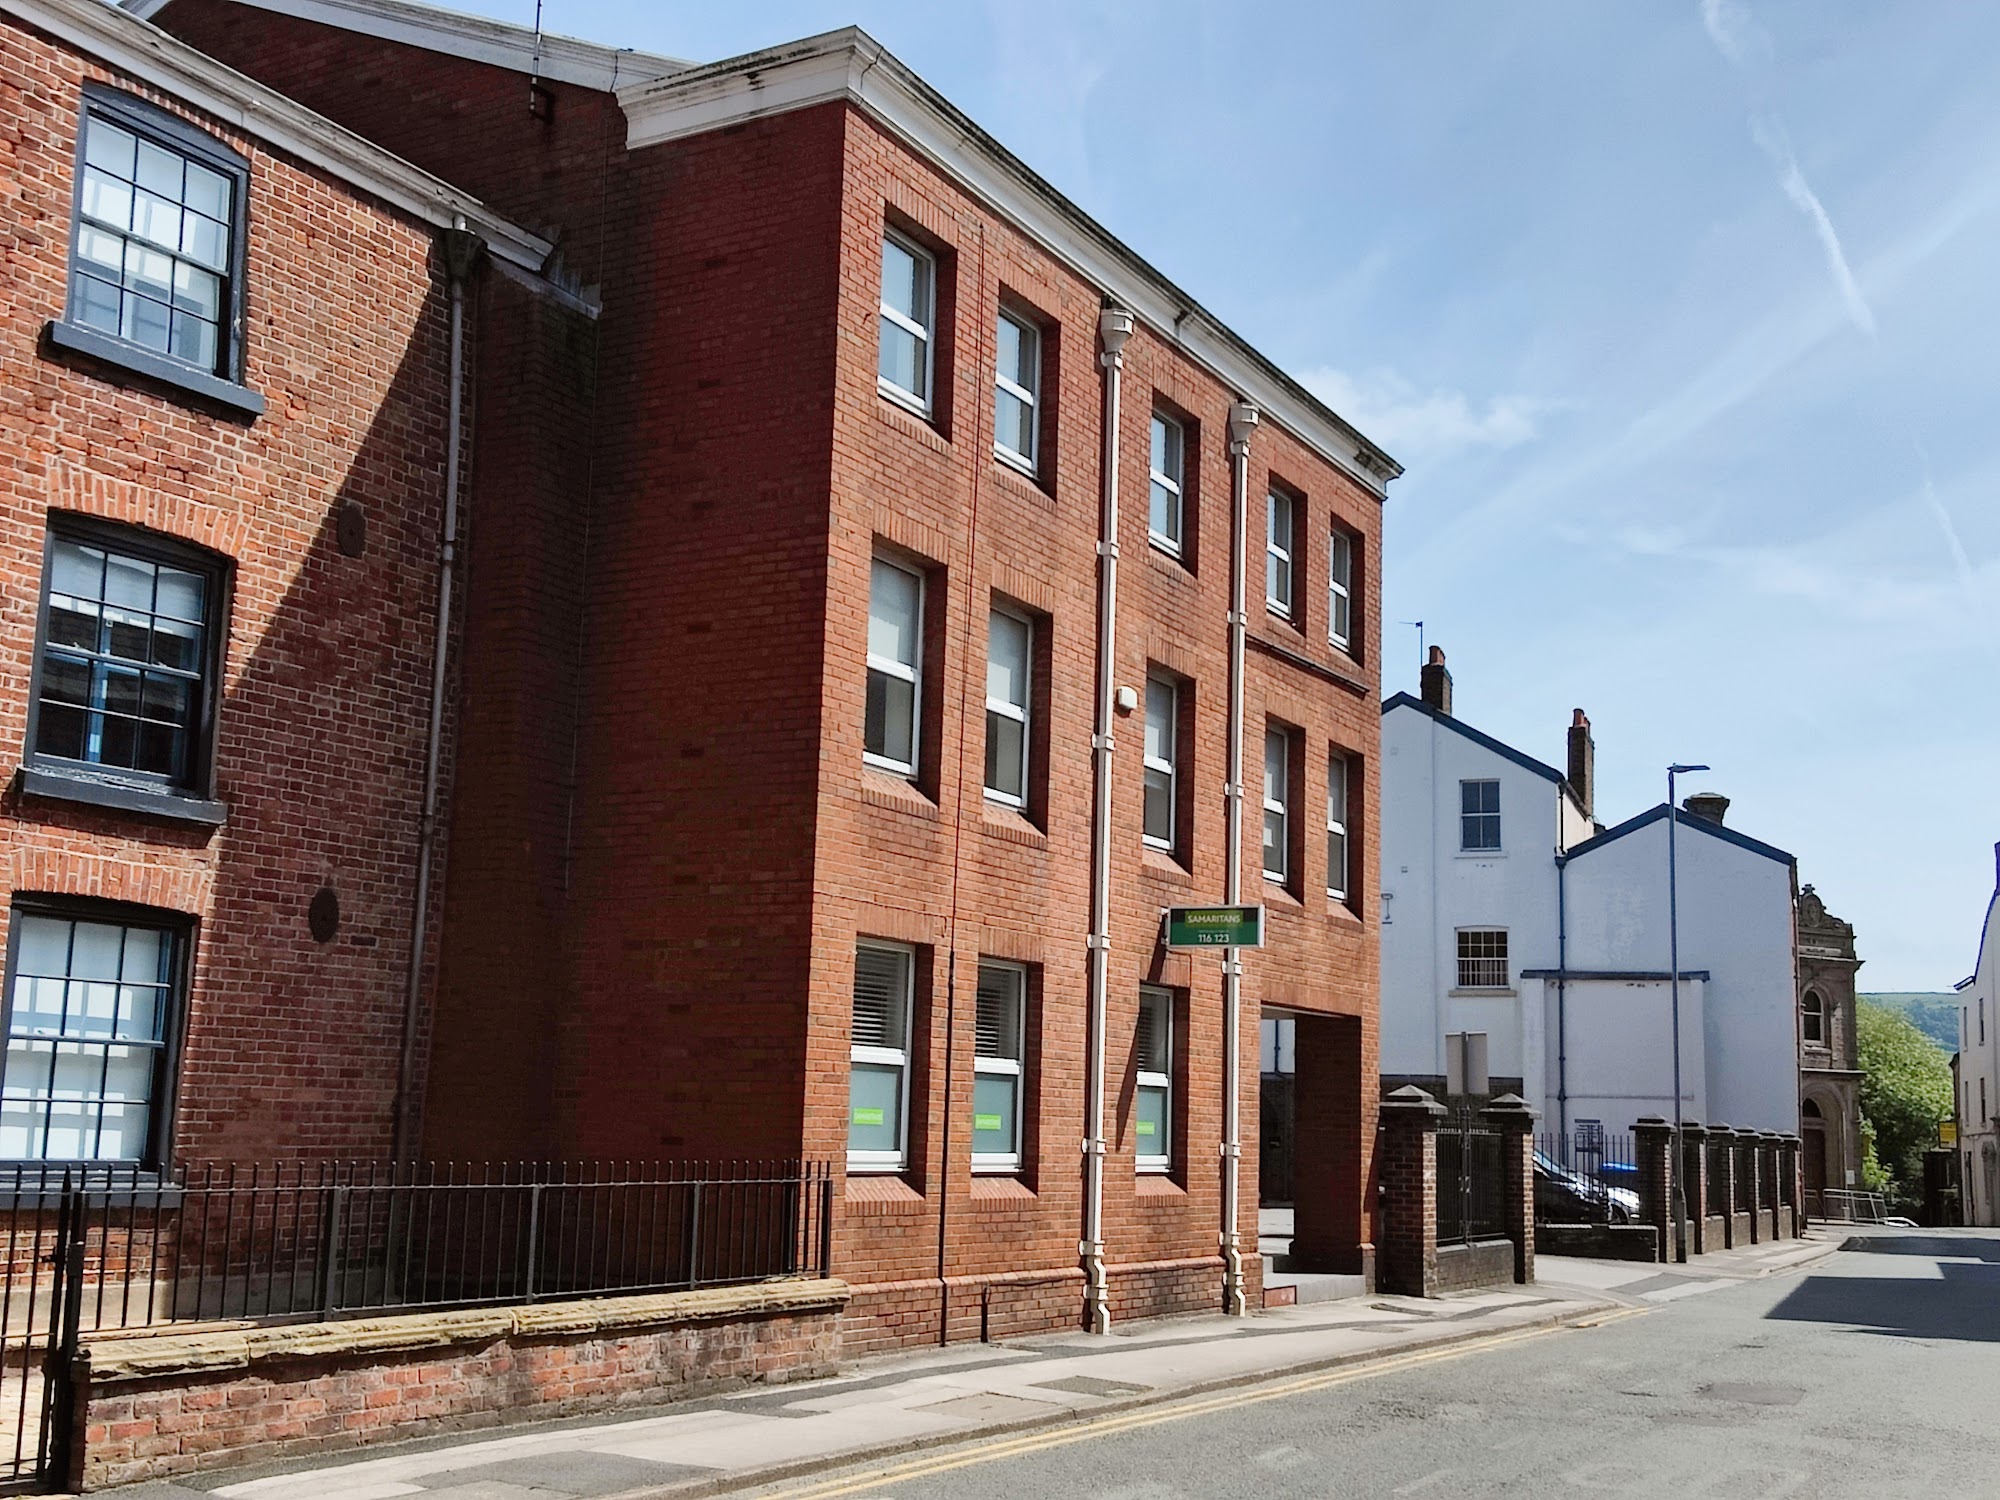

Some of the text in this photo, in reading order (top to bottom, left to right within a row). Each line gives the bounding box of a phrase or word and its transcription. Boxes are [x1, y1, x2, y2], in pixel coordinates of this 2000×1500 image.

[1187, 914, 1241, 924] SAMARITANS
[1198, 933, 1230, 943] 116 123
